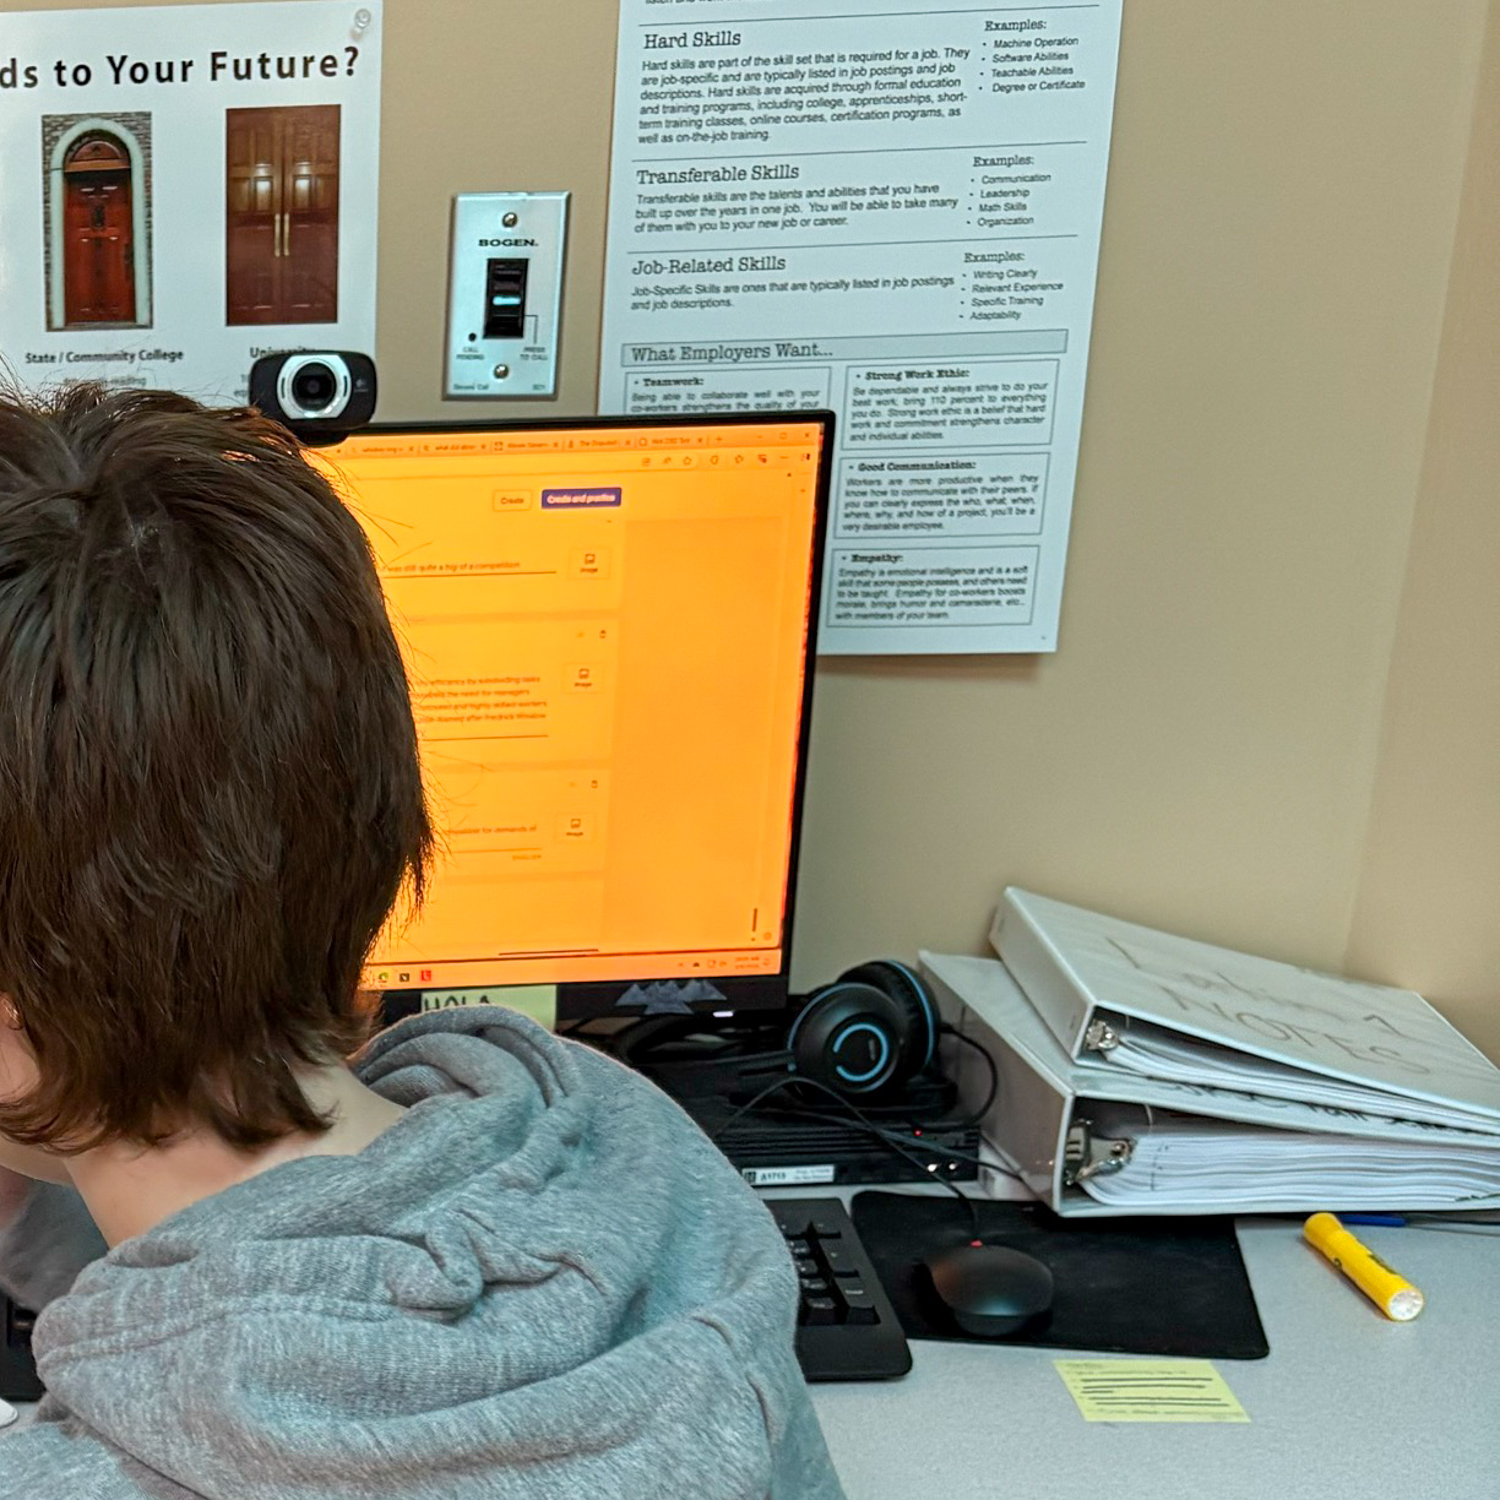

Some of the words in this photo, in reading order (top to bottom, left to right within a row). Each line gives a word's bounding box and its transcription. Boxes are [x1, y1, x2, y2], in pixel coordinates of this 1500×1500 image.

[984, 19, 1046, 32] Examples:
[644, 32, 687, 49] Hard
[692, 30, 740, 47] Skills
[993, 39, 1031, 48] Machine
[1033, 36, 1078, 47] Operation
[642, 60, 667, 70] Hard
[670, 59, 695, 69] skills
[698, 60, 715, 68] are
[717, 58, 738, 68] part
[740, 56, 751, 66] of
[753, 56, 770, 66] the
[773, 55, 793, 65] skill
[795, 54, 812, 64] set
[814, 53, 834, 63] that
[836, 54, 846, 62] is
[848, 51, 892, 62] required
[894, 50, 908, 60] for
[911, 51, 918, 59] a
[921, 49, 940, 60] job.
[945, 48, 969, 59] They
[992, 53, 1032, 62] Software
[1033, 51, 1068, 61] Abilities
[54, 60, 91, 86] to
[107, 53, 192, 84] Your
[210, 46, 358, 80] Future?
[641, 76, 658, 85] are
[660, 73, 718, 85] job-specific
[721, 73, 741, 82] and
[743, 72, 761, 81] are
[763, 69, 805, 81] typically
[808, 68, 836, 78] listed
[838, 68, 848, 76] in
[850, 66, 867, 78] job
[869, 65, 913, 78] postings
[916, 64, 936, 74] and
[938, 63, 955, 74] job
[992, 68, 1036, 77] Teachable
[1038, 66, 1073, 75] Abilities
[640, 89, 704, 100] descriptions.
[707, 87, 733, 97] Hard
[736, 86, 761, 96] skills
[764, 86, 781, 95] are
[783, 84, 829, 94] acquired
[831, 81, 871, 94] through
[874, 79, 907, 90] formal
[909, 78, 961, 88] education
[992, 82, 1025, 93] Degree
[1039, 80, 1085, 90] Certificate
[639, 105, 659, 114] and
[661, 104, 700, 114] training
[702, 102, 752, 112] programs,
[757, 99, 803, 111] including
[805, 97, 845, 109] college,
[848, 94, 933, 106] apprenticeships,
[937, 92, 966, 102] short-
[972, 155, 1034, 167] Examples:
[636, 166, 747, 184] Transferable
[751, 164, 799, 180] Skills
[981, 173, 1051, 184] Communication
[980, 189, 1029, 198] Leadership
[631, 257, 733, 274] Job-Related
[738, 255, 785, 271] Skills
[963, 251, 1024, 263] Examples:
[25, 352, 56, 363] State
[58, 351, 63, 363] /
[65, 351, 135, 362] Community
[138, 349, 183, 362] College
[632, 346, 675, 361] What
[680, 344, 770, 363] Employers
[776, 342, 832, 360] Want...
[1161, 986, 1431, 1074] NOTES
